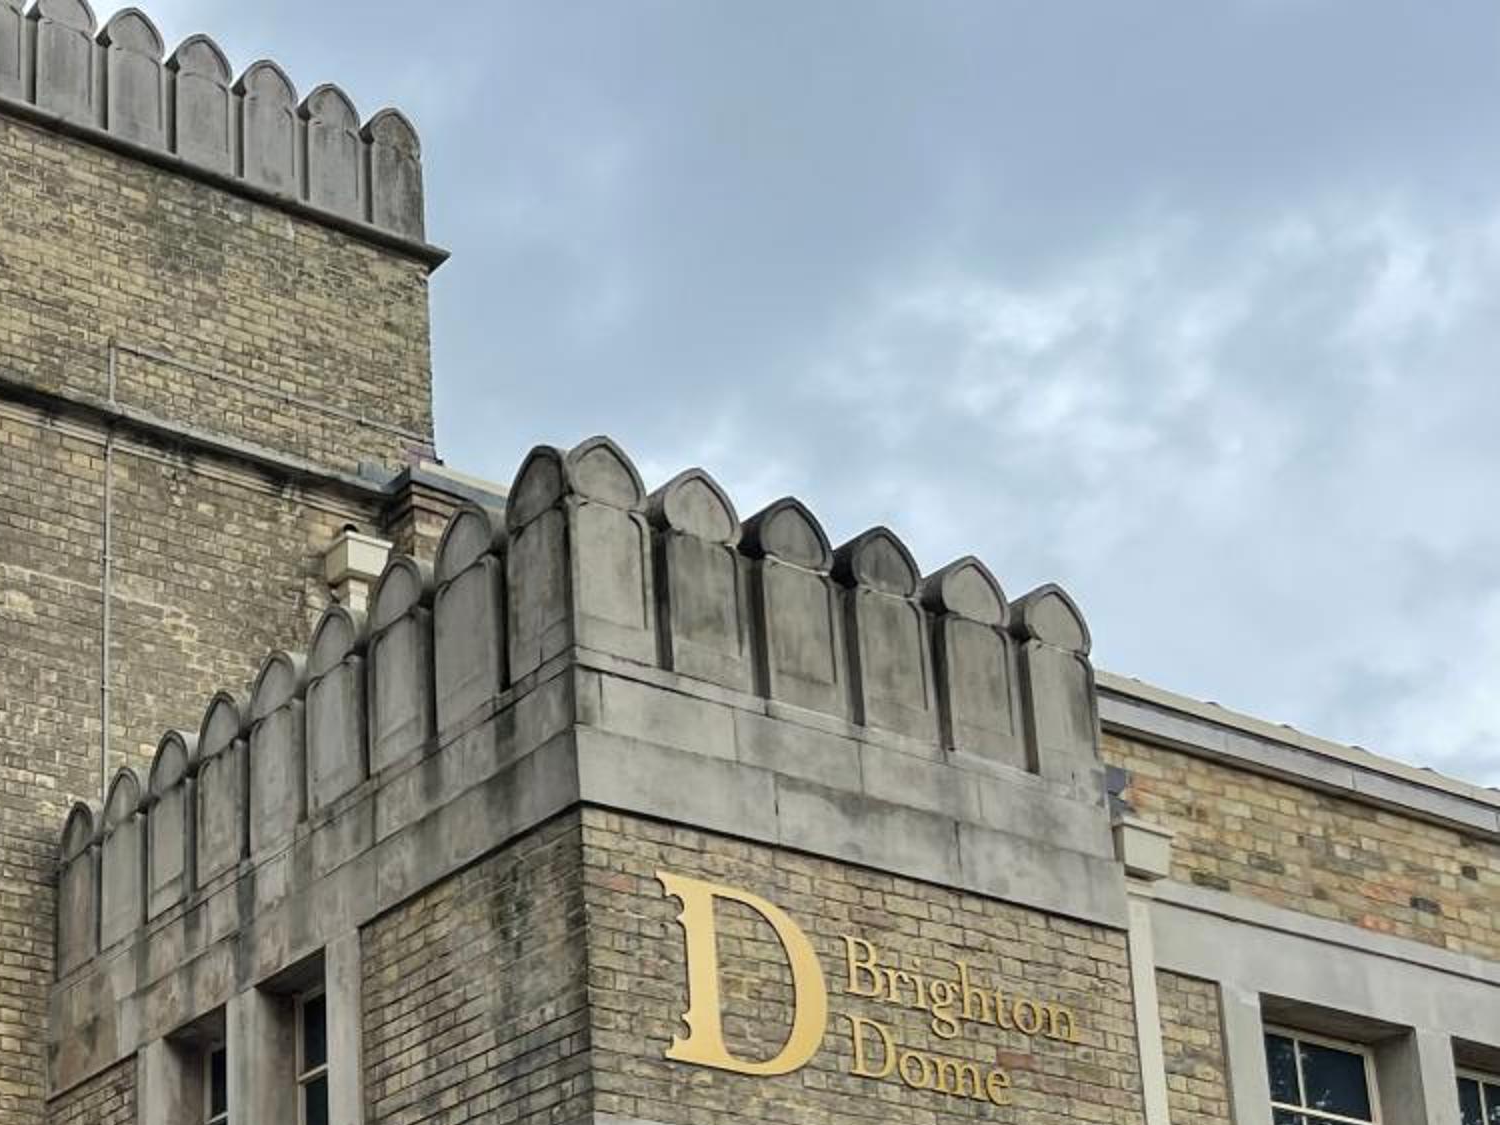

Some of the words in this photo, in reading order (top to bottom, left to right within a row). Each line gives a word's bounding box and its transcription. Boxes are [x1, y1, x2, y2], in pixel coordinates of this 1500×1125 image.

[656, 870, 827, 1076] D
[842, 935, 1081, 1043] Brighton
[842, 1014, 1012, 1106] Dome
